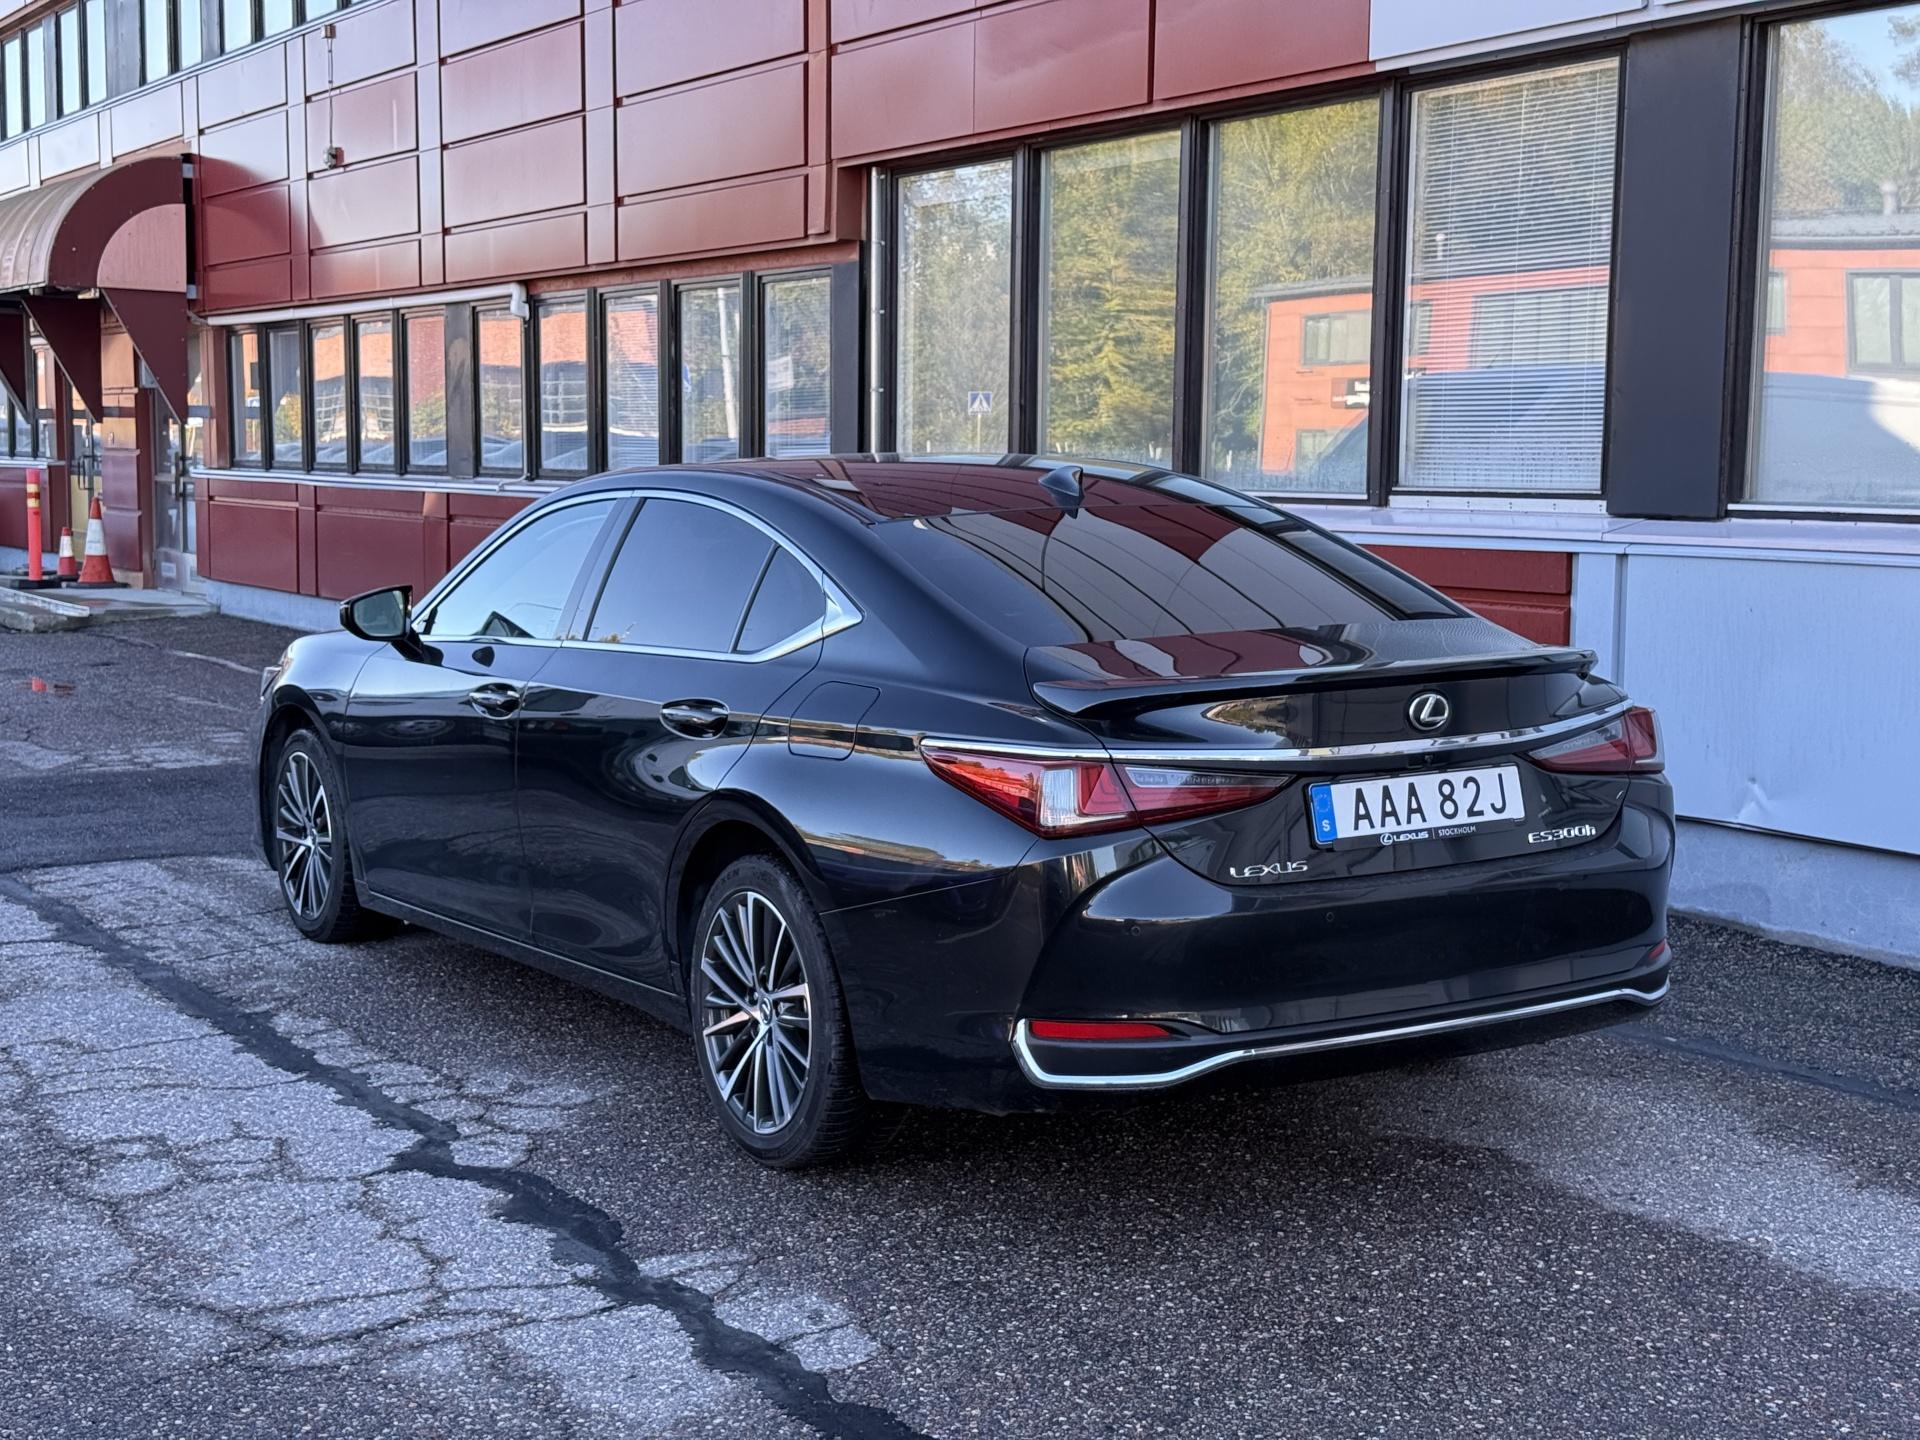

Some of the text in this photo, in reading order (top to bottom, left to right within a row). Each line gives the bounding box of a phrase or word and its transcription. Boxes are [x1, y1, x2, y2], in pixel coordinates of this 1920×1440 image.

[1353, 772, 1507, 831] AAA 82J
[1322, 819, 1331, 832] S
[1393, 831, 1429, 842] LEXUS
[1438, 825, 1476, 837] STOCKHOLM
[1528, 824, 1597, 844] ES300h
[1229, 860, 1308, 878] LEXUS
